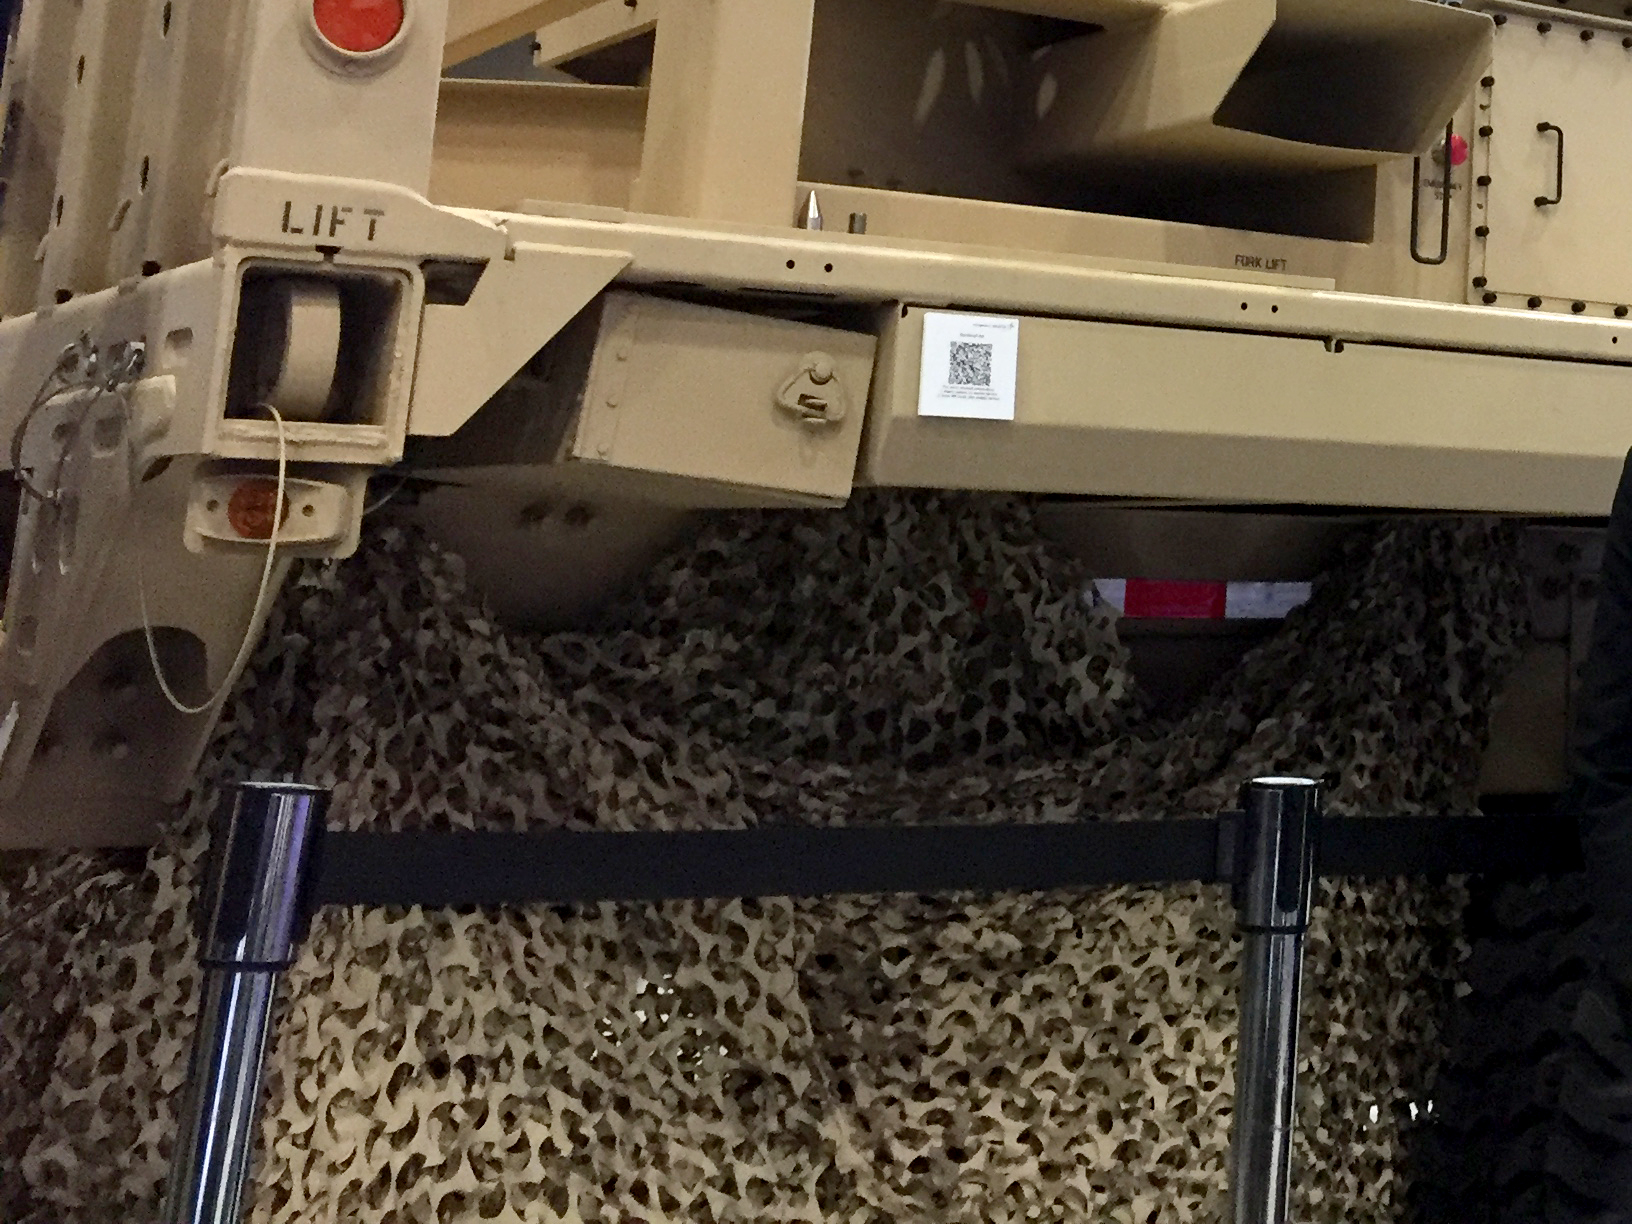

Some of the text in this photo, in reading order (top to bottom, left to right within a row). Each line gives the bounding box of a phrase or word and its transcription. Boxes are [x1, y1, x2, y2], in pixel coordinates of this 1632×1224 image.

[281, 200, 385, 241] LIFT
[1234, 254, 1288, 271] FORK LIFT
